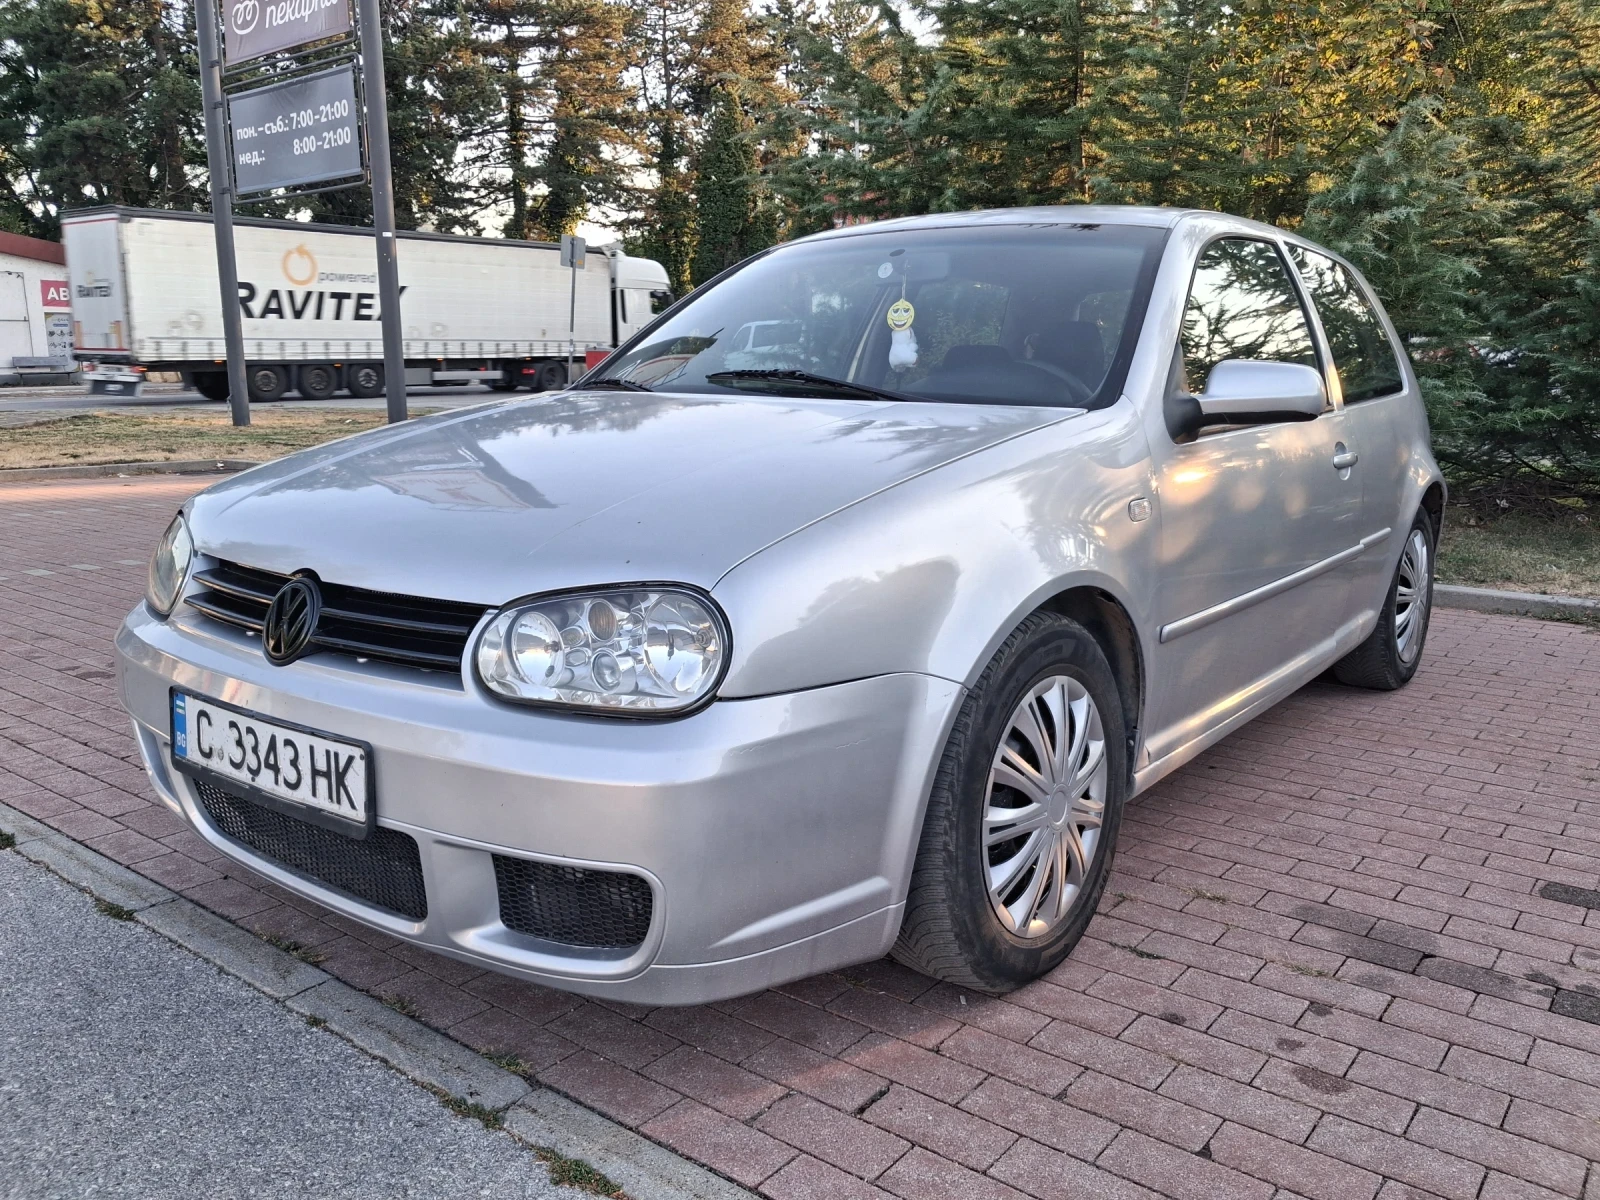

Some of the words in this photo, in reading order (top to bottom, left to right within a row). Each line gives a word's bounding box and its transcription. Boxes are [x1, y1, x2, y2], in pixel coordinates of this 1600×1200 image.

[290, 99, 349, 130] 7:00-21:00
[239, 149, 266, 166] нед.:
[293, 126, 351, 155] 8:00-21:00
[317, 271, 377, 284] powered
[237, 281, 409, 321] RAVITE
[176, 731, 187, 748] BG
[228, 720, 302, 791] 3343
[308, 743, 359, 811] HK
